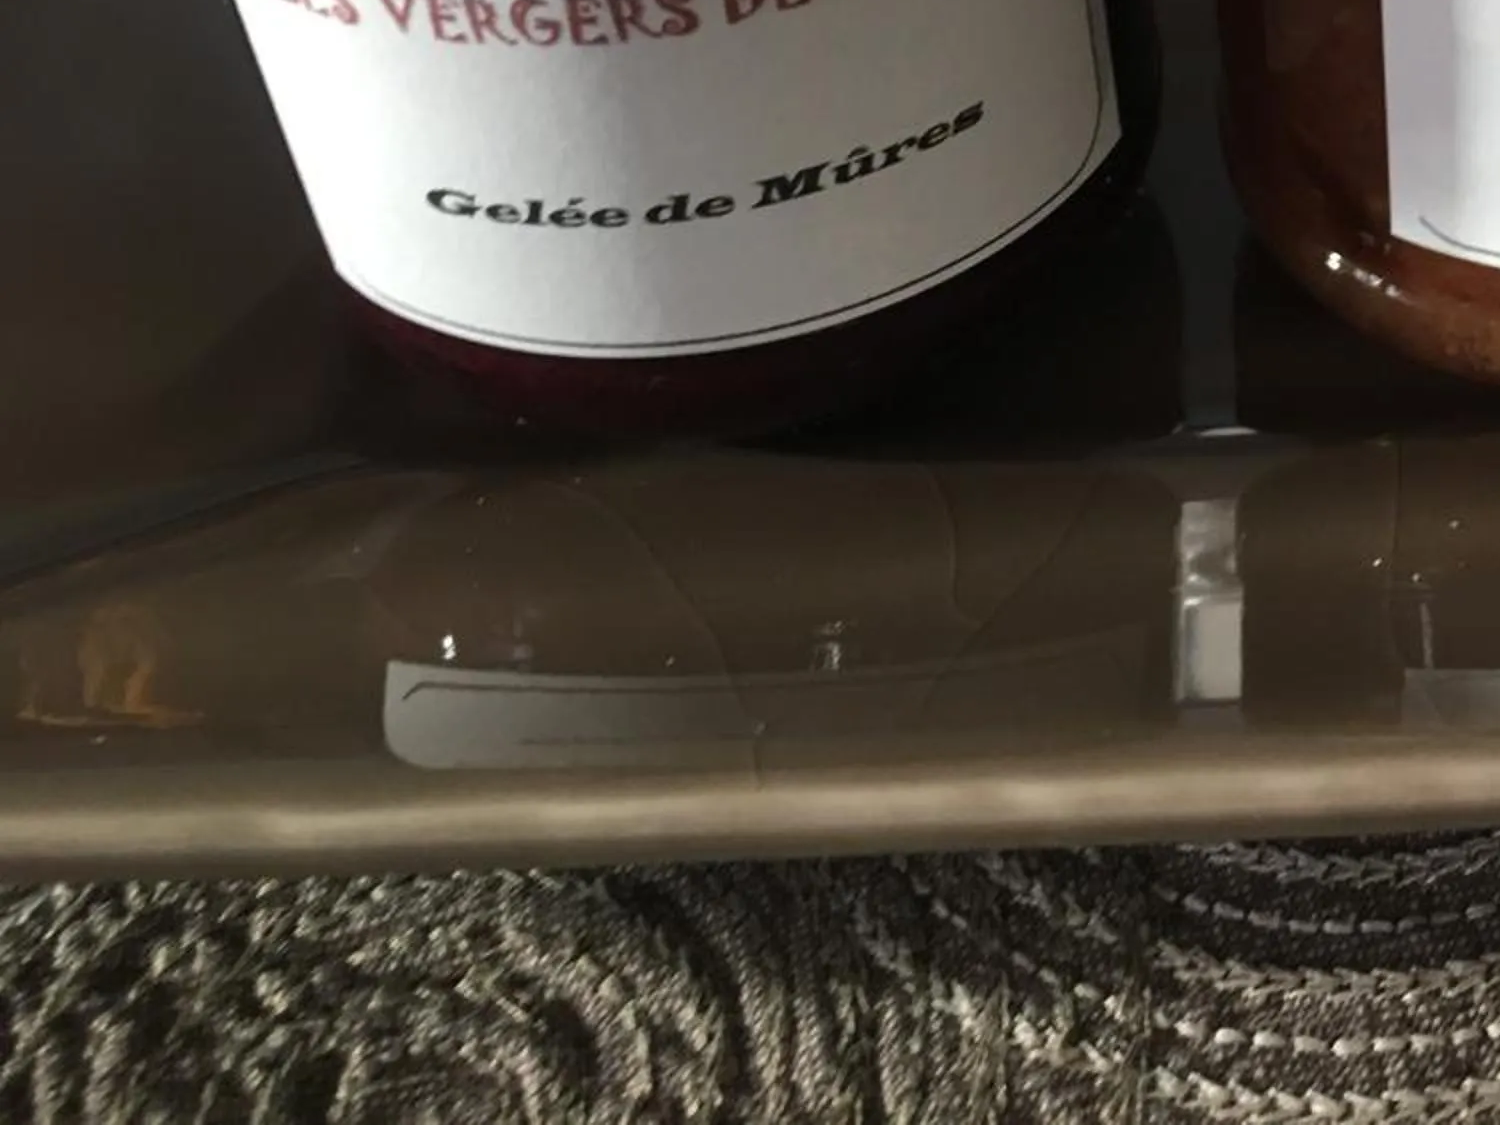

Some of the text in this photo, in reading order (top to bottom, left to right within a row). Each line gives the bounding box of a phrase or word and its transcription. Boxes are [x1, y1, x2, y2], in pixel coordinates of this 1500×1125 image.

[426, 100, 985, 229] Gelée de Mûres
